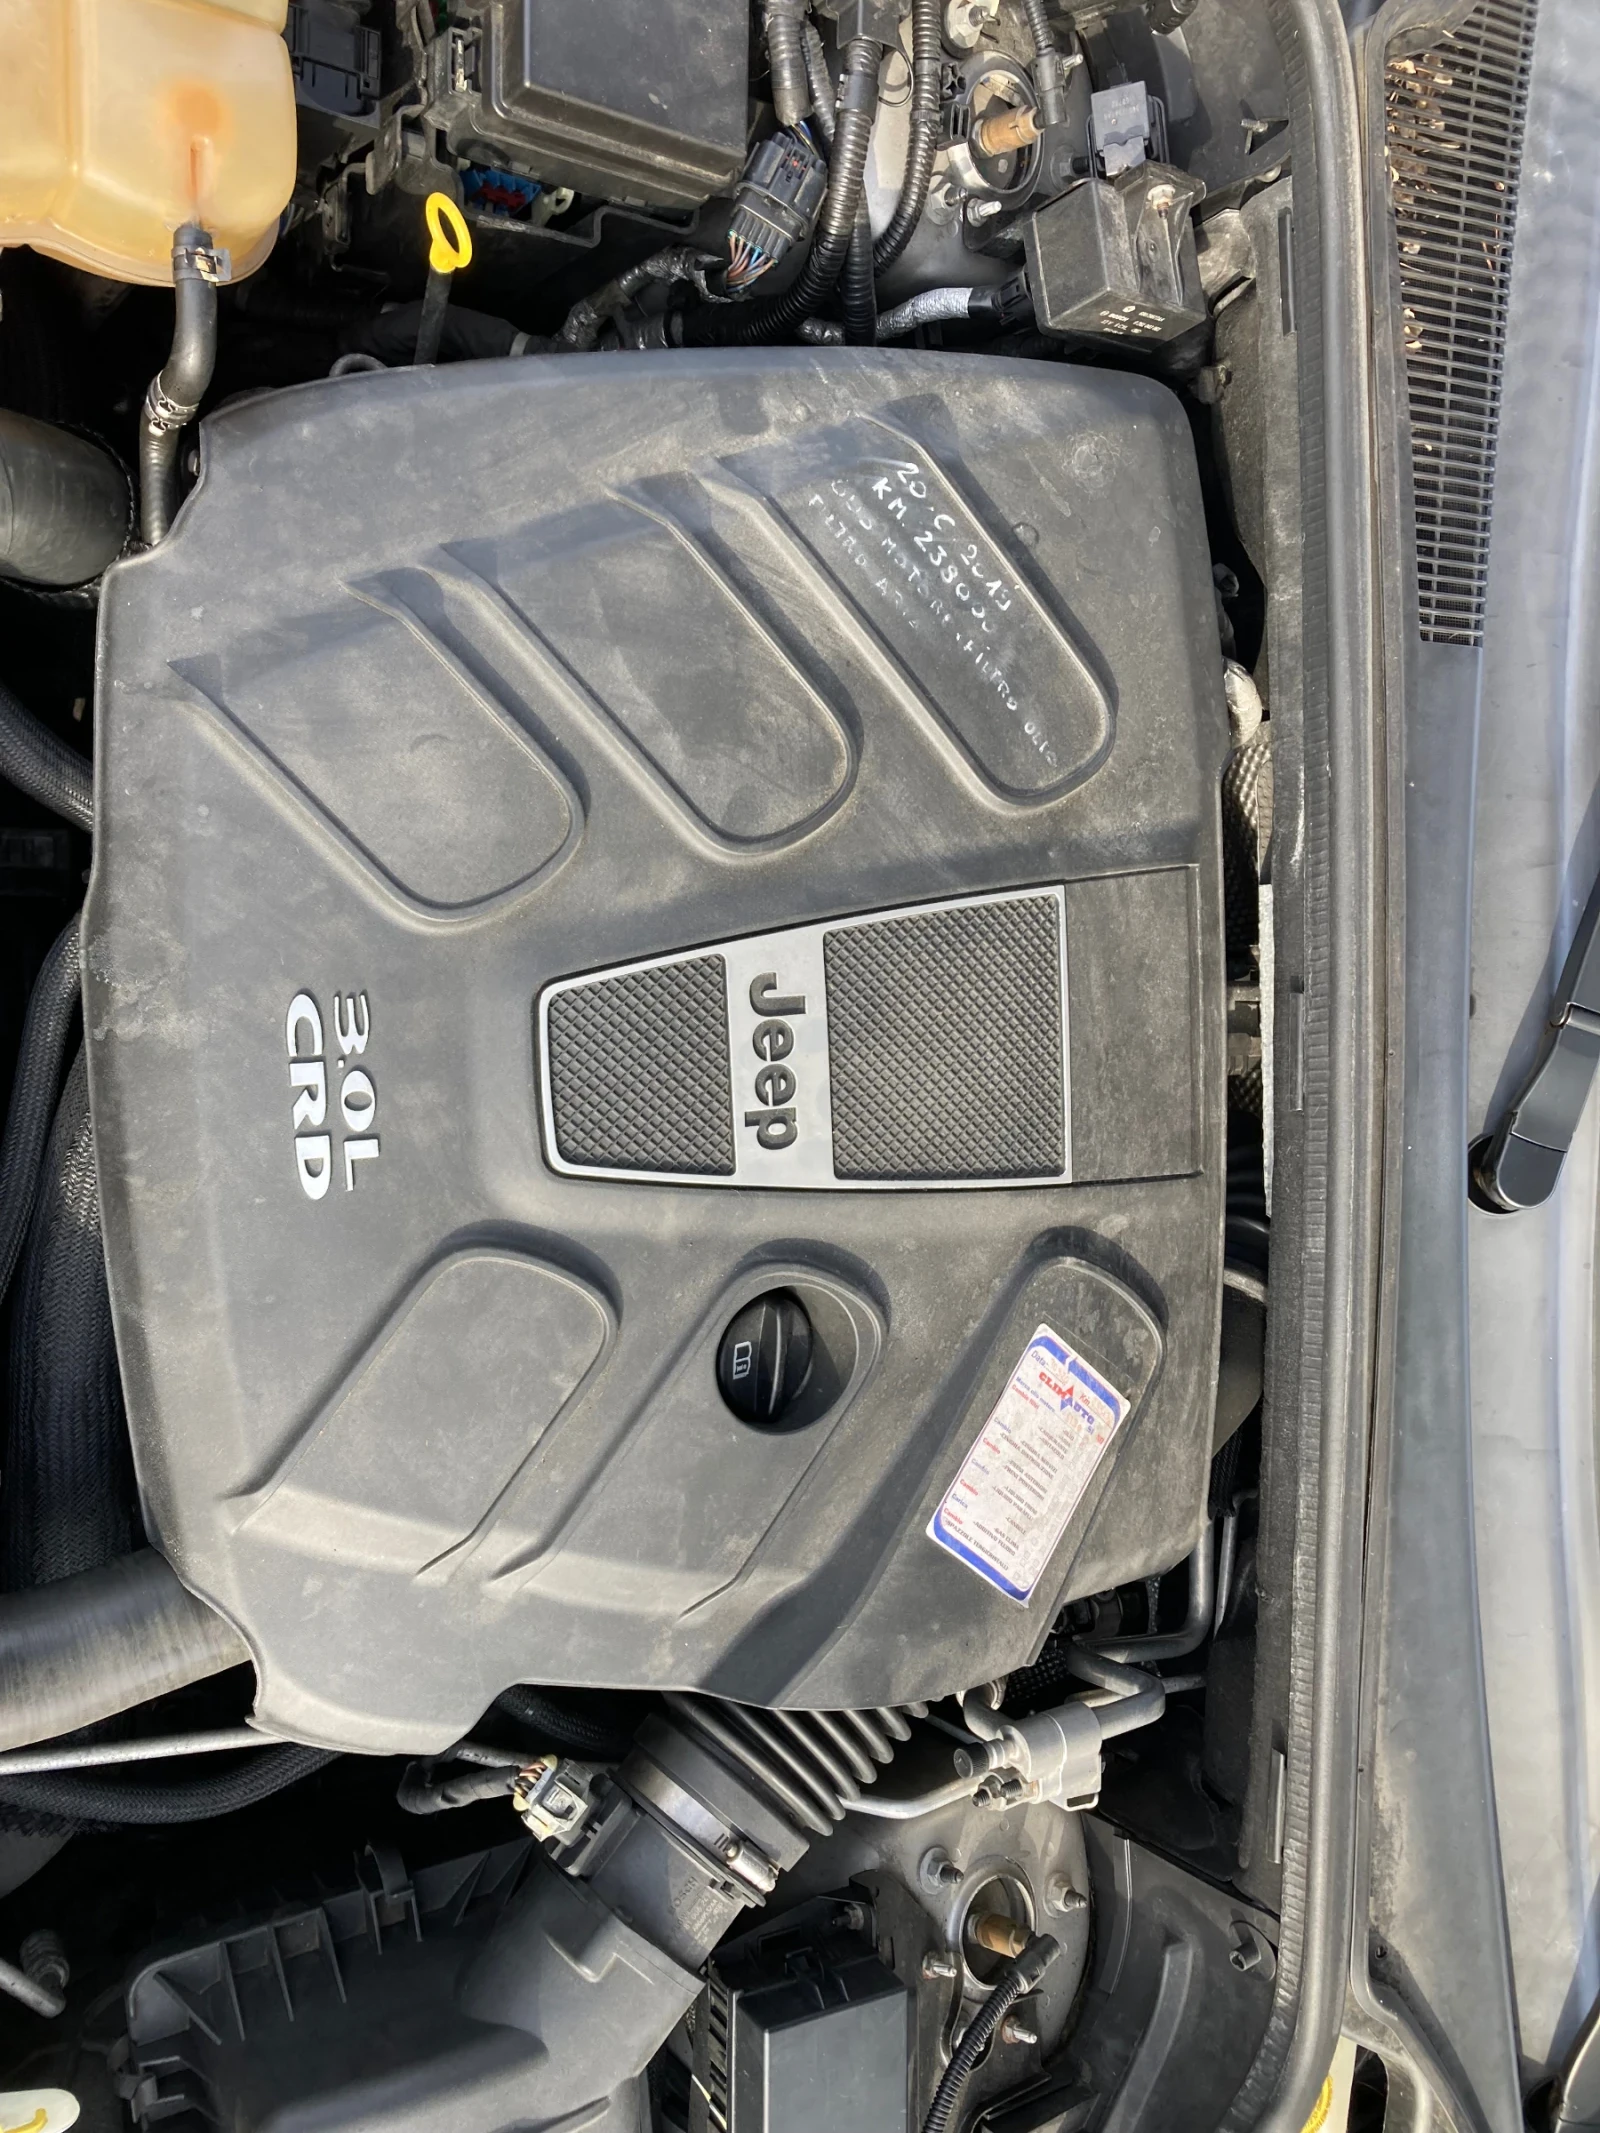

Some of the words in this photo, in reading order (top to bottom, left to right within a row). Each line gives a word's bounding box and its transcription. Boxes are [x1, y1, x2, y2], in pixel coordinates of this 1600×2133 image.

[745, 972, 806, 1150] Jeep
[287, 994, 332, 1200] CRD
[334, 994, 380, 1192] 3.0L
[1036, 1370, 1096, 1425] CLIMAUTO
[993, 1416, 1012, 1434] Cambio
[981, 1436, 1001, 1455] Cambio
[958, 1477, 979, 1496] Cambio
[950, 1492, 969, 1509] Carica
[942, 1507, 963, 1525] Cambio
